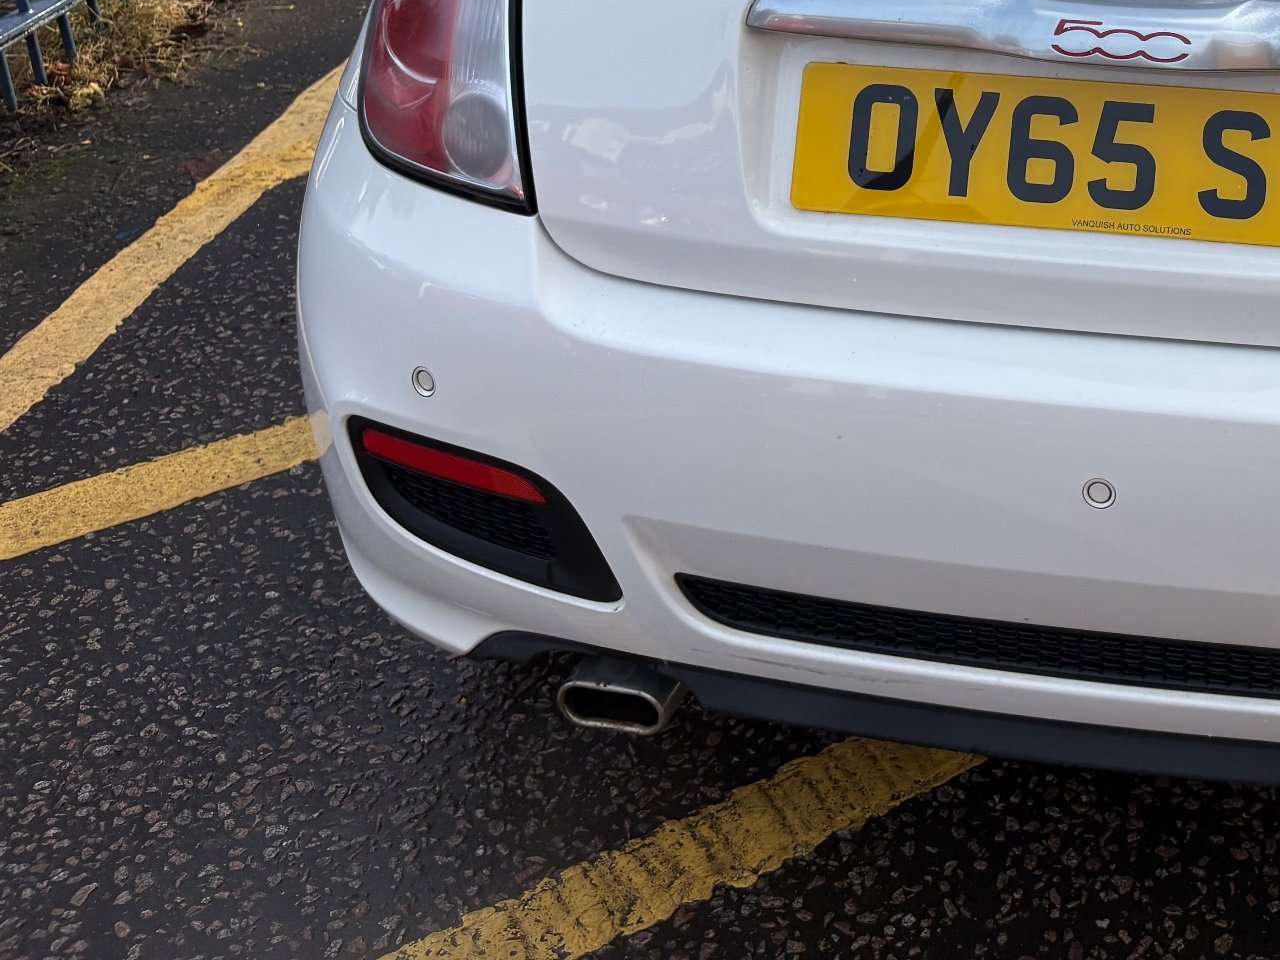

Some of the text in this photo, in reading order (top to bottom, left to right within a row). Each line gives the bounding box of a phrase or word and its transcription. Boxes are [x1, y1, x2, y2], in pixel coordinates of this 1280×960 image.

[1051, 19, 1192, 62] 500
[847, 83, 1157, 212] OY65
[1072, 218, 1192, 236] VANQUISH AUTO SOLUTIONS
